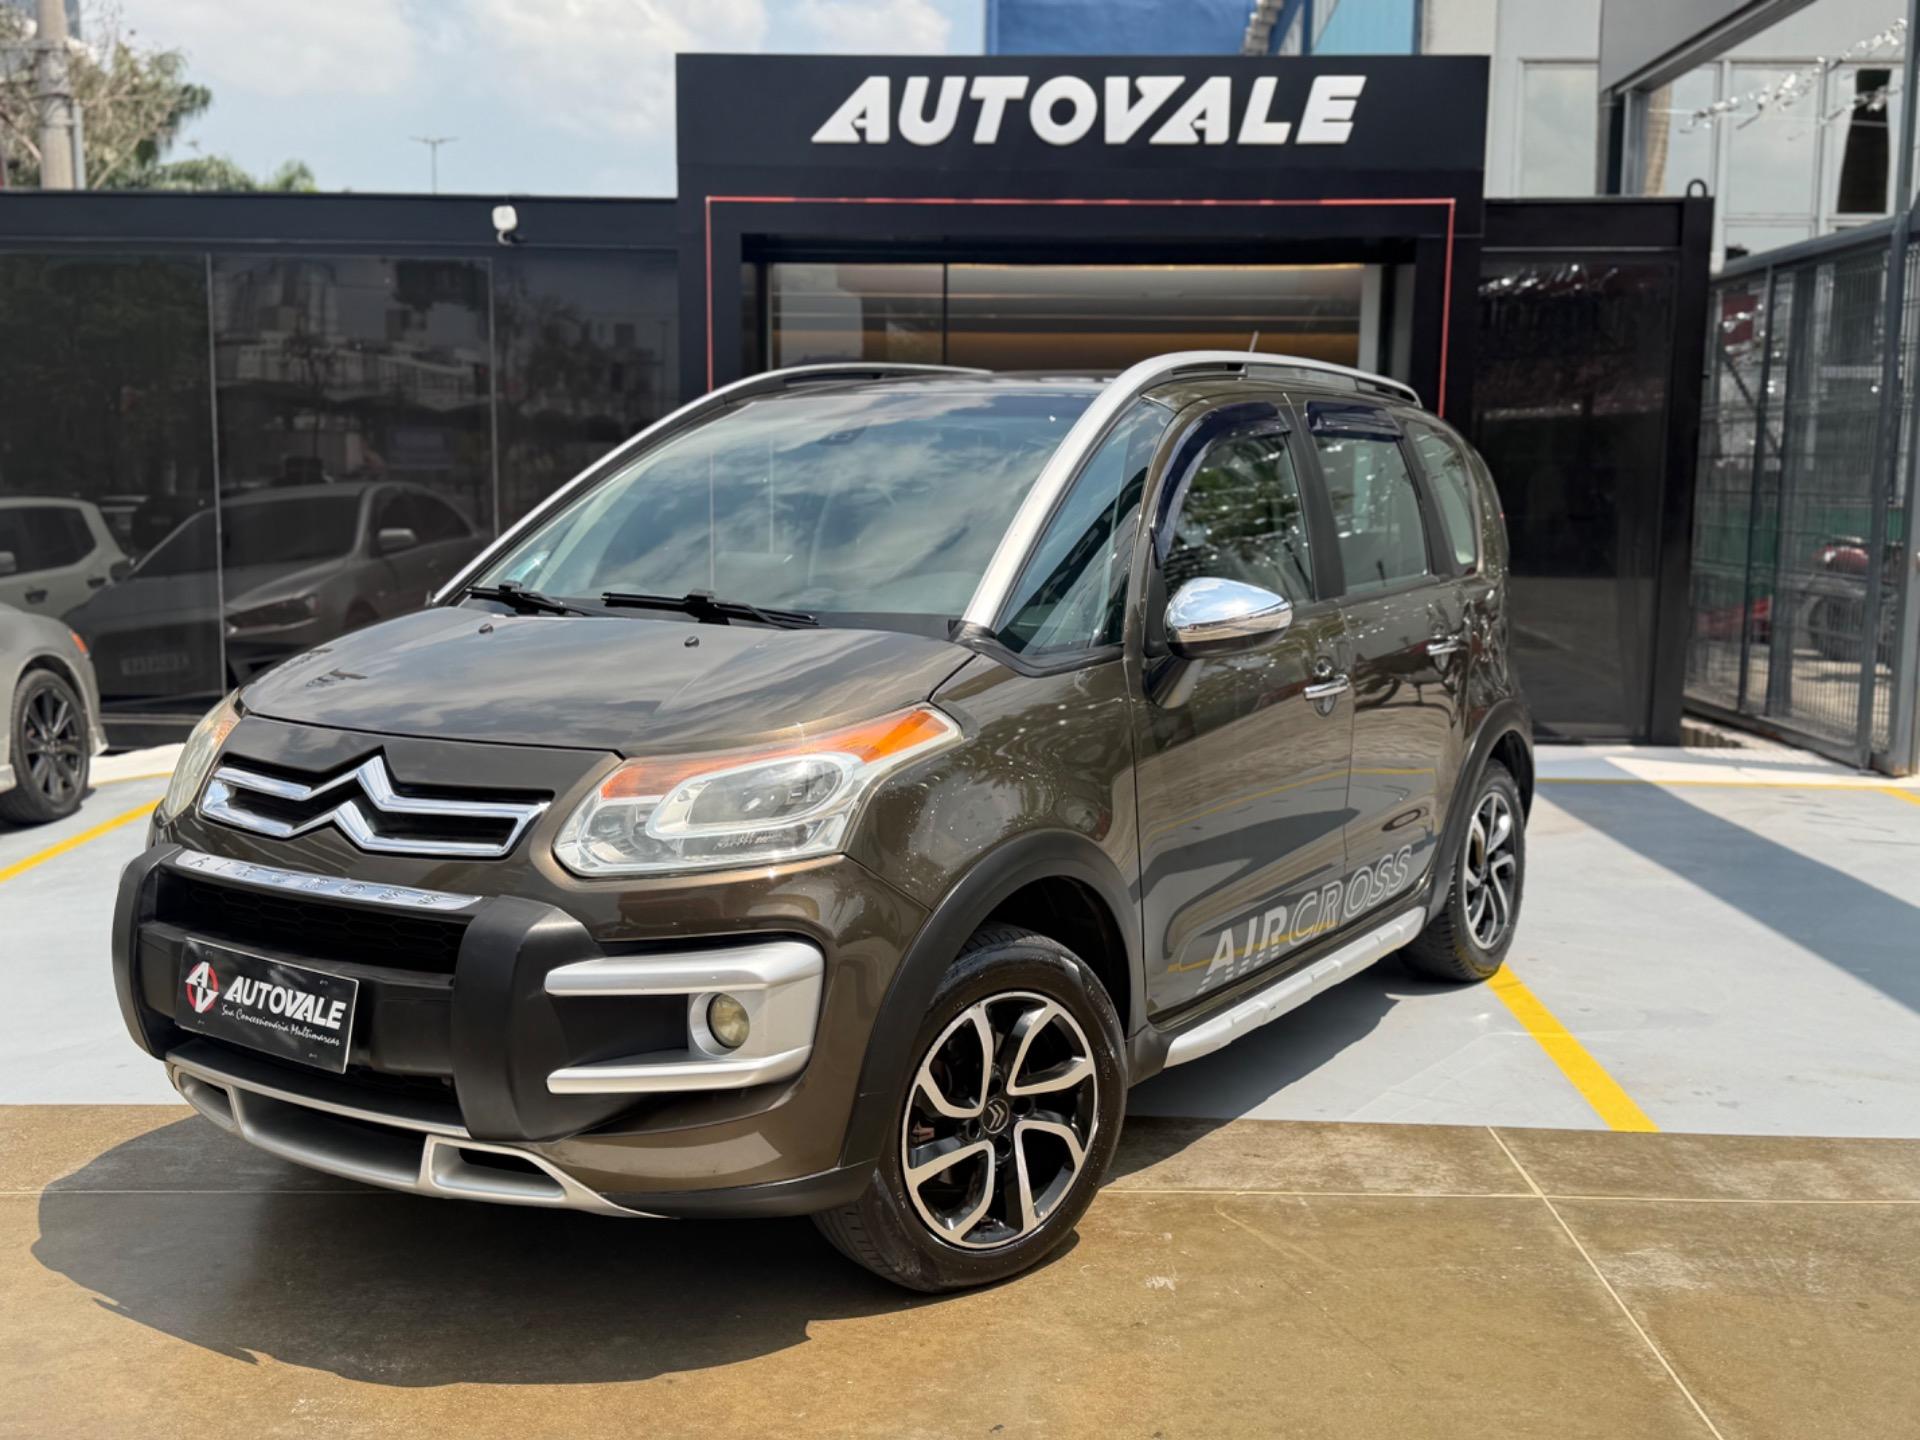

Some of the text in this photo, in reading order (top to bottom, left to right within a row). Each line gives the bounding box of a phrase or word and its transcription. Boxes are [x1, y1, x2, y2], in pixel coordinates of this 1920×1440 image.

[812, 75, 1367, 145] AUTOVALE
[1197, 844, 1412, 993] AIRCROSS
[223, 975, 346, 1030] AUTOVALE
